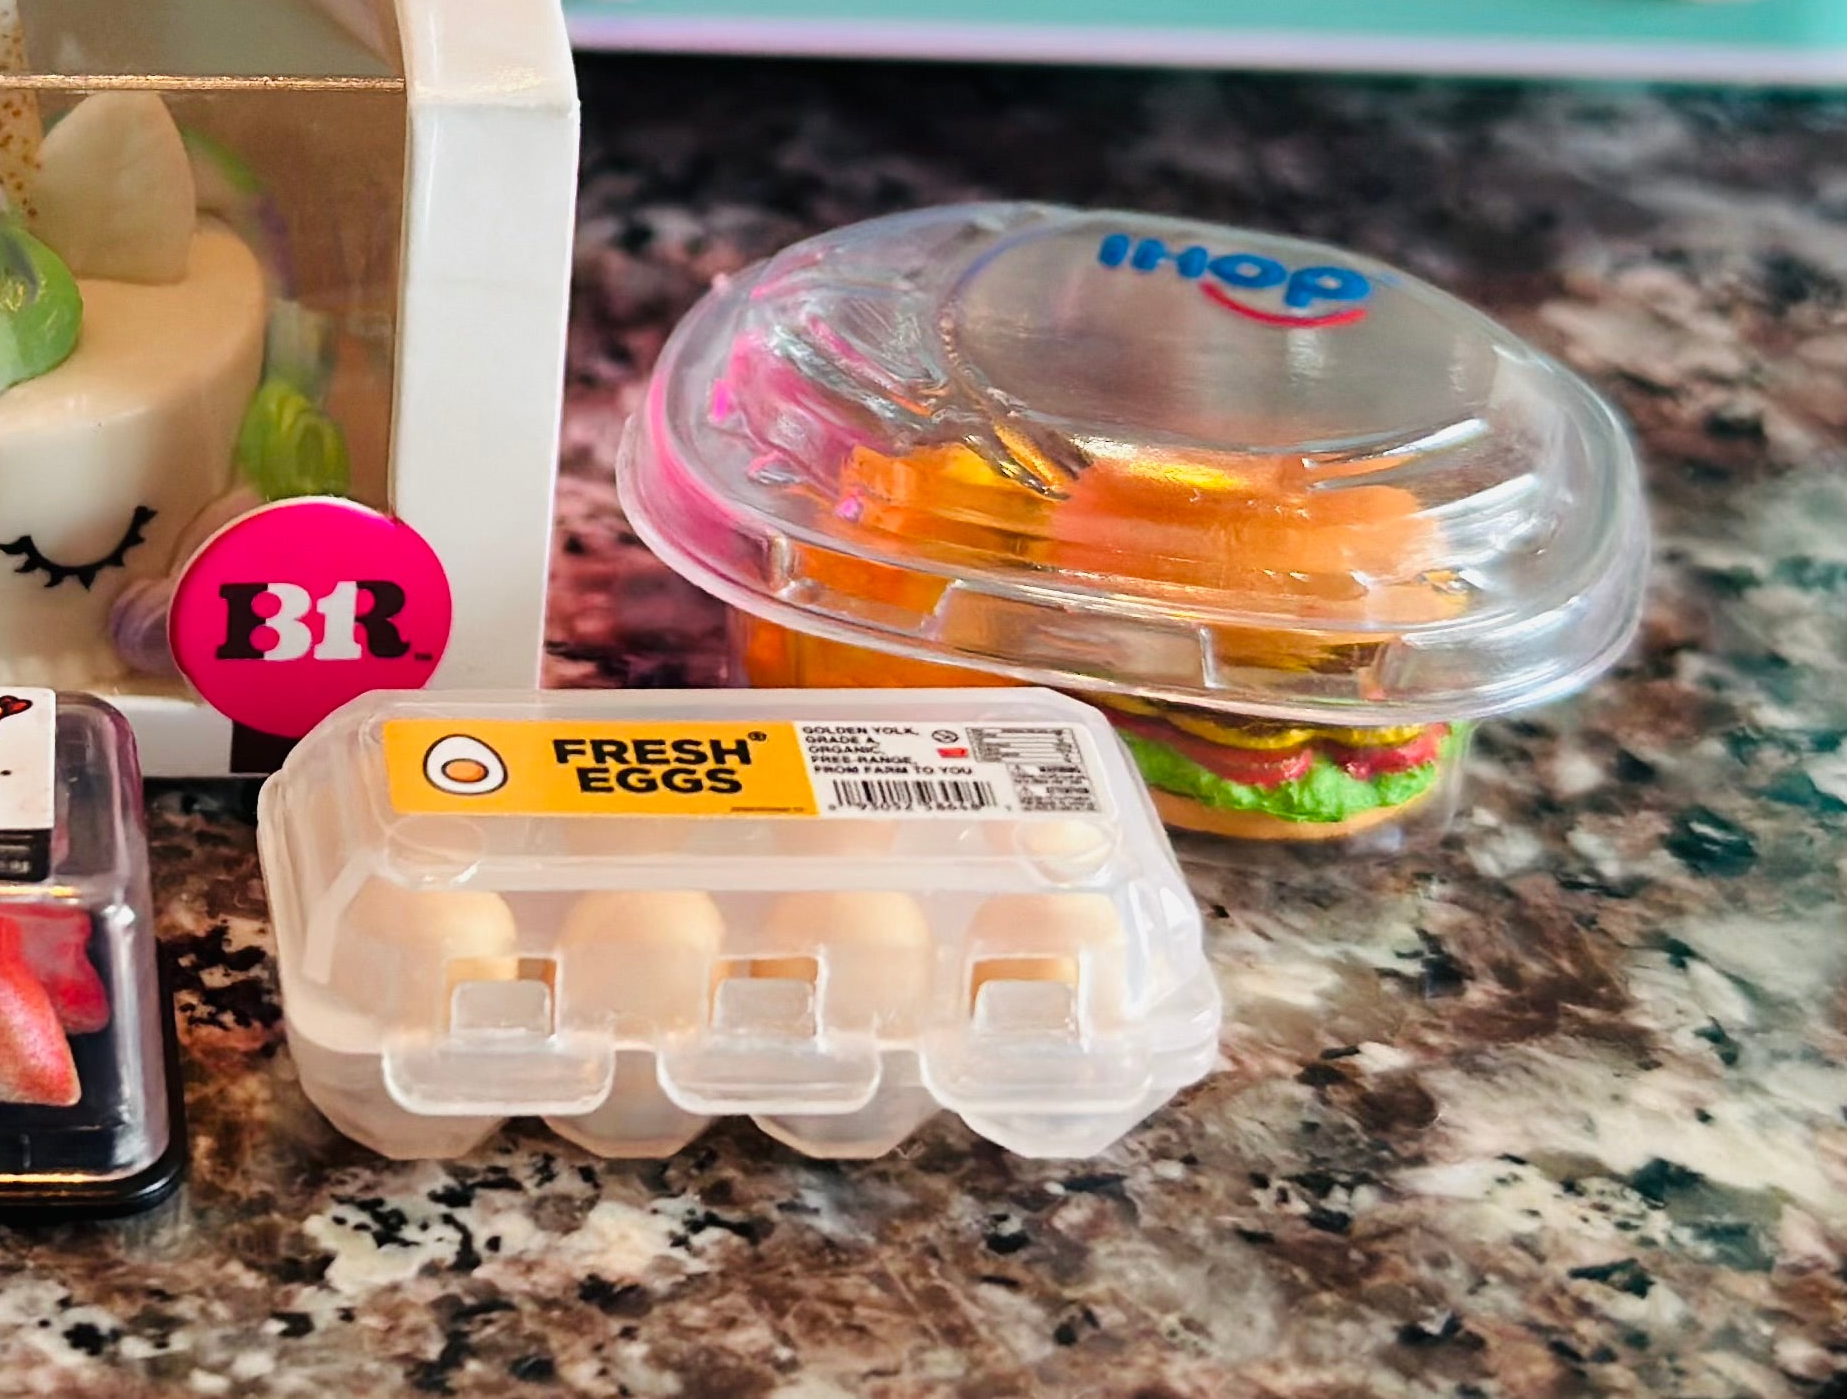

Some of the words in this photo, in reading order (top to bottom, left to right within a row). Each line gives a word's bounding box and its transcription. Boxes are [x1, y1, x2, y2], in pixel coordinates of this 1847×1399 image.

[215, 580, 412, 662] BR
[802, 726, 868, 735] GOLDEN
[805, 736, 859, 744] GRADE
[553, 738, 752, 768] FRESH
[814, 766, 859, 774] FROM
[864, 766, 909, 774] FARM
[915, 766, 934, 774] TO
[939, 766, 973, 775] YOU
[578, 766, 744, 794] EGGS
